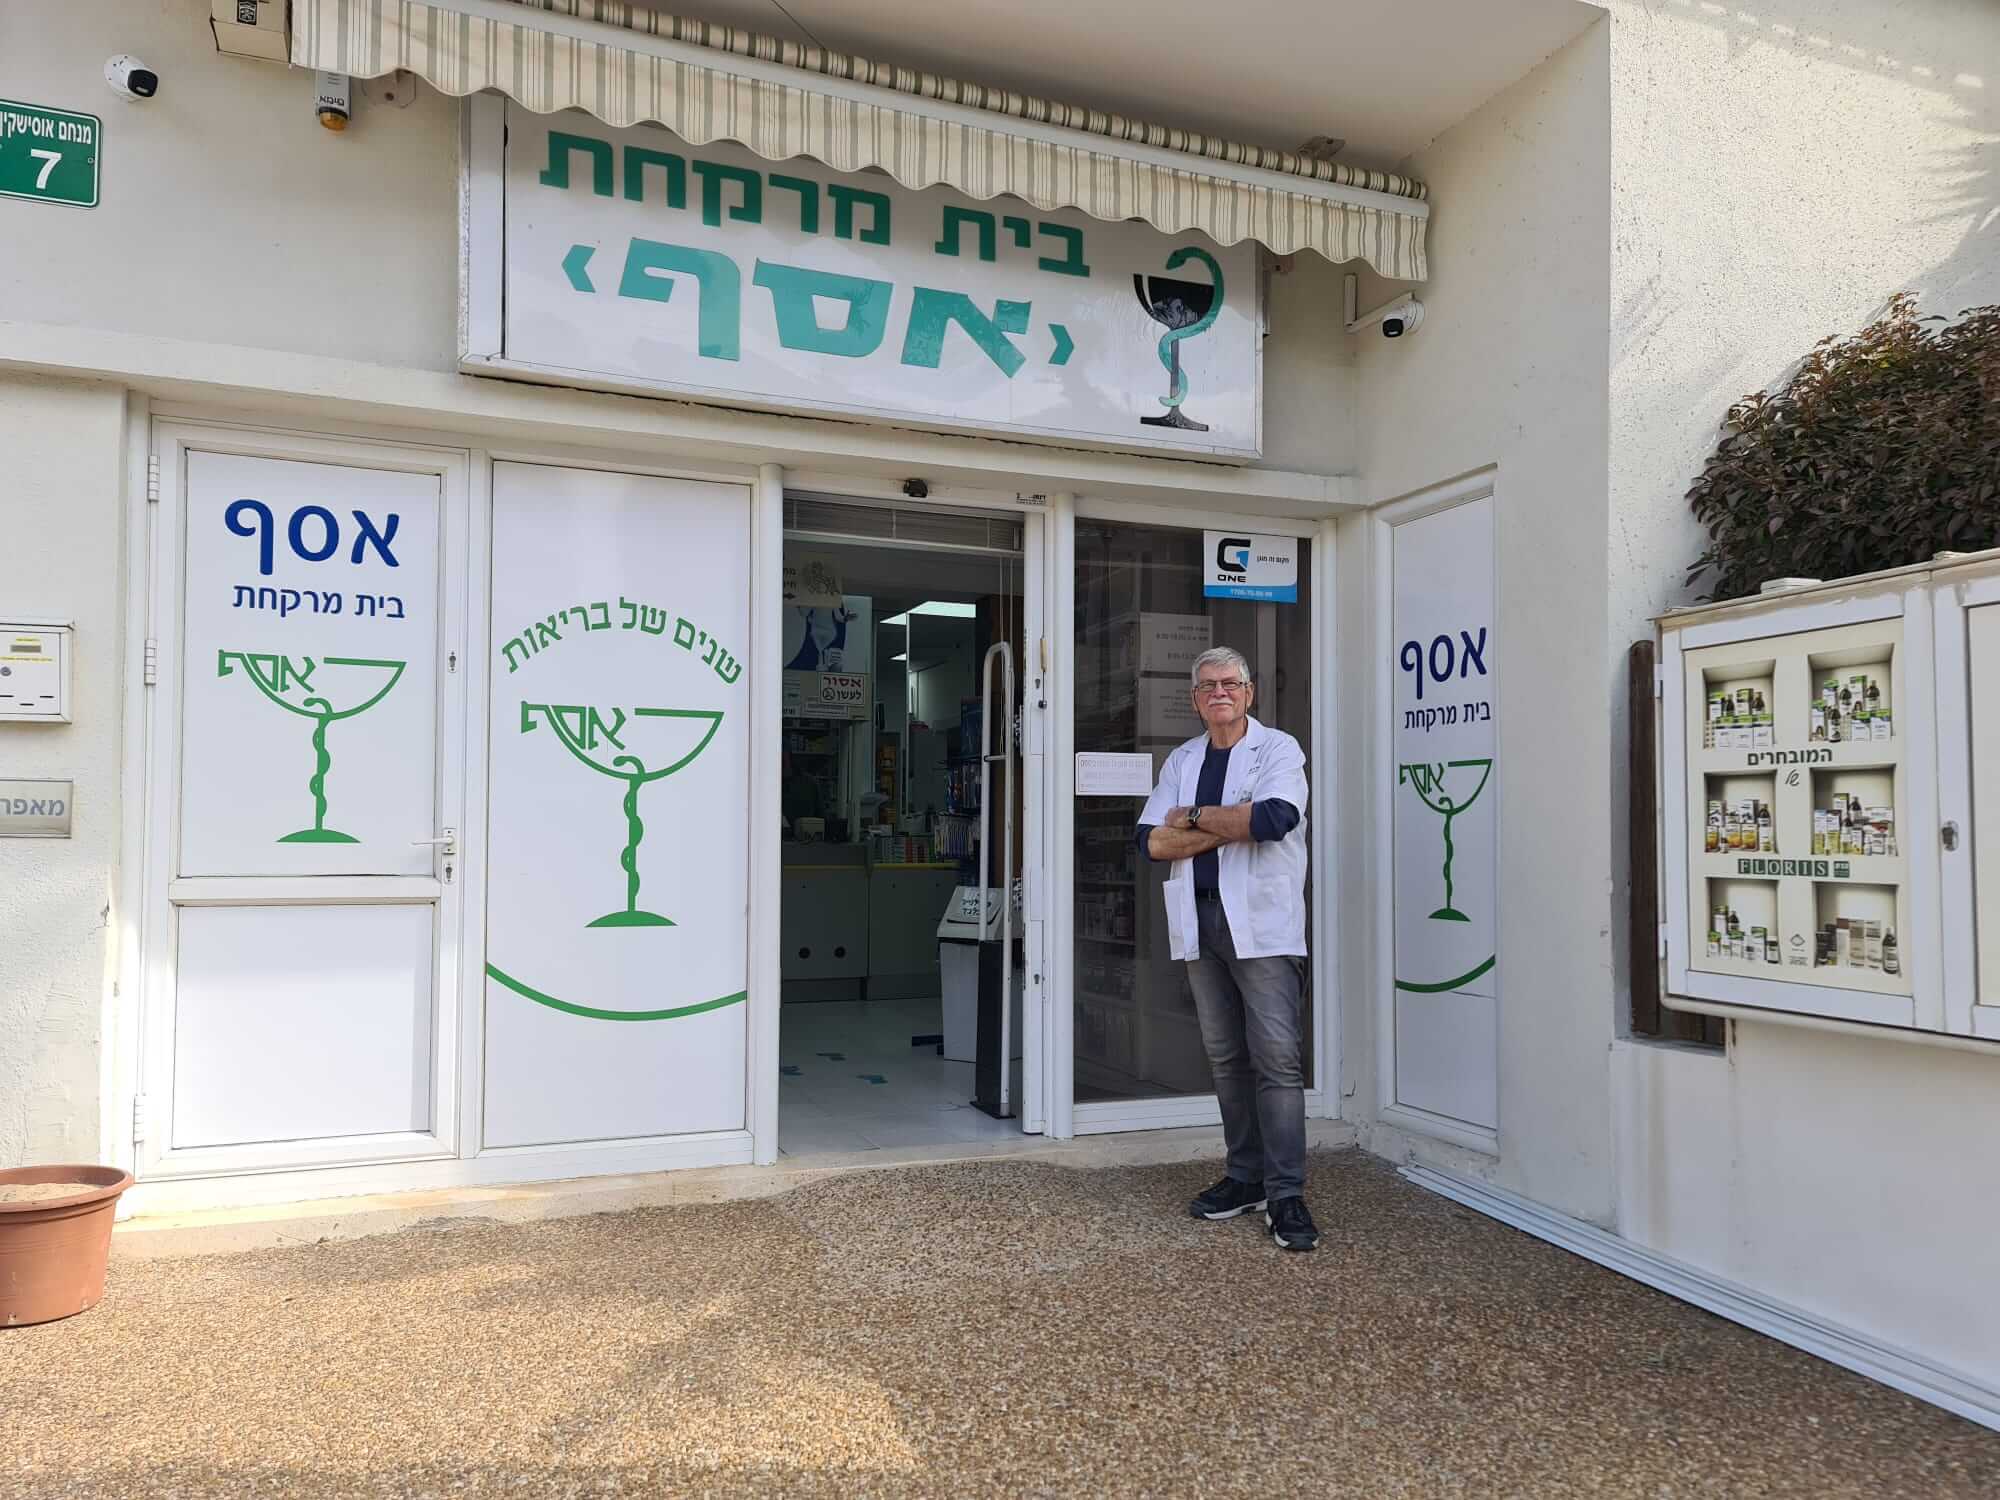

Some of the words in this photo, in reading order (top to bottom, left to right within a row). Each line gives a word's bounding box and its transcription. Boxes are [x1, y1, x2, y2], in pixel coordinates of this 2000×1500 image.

[58, 120, 92, 145] מנחם
[31, 149, 62, 189] 7
[539, 130, 892, 246] מרקחת
[935, 205, 1091, 278] בית
[618, 237, 1032, 378] אסף
[224, 499, 400, 576] אסף
[1217, 574, 1247, 583] ONE
[233, 586, 342, 617] מרקחת
[355, 592, 405, 618] בית
[619, 596, 667, 635] של
[501, 602, 612, 674] בריאות
[673, 616, 743, 684] שנים
[1400, 627, 1487, 700] אסף
[823, 676, 862, 688] אסור
[836, 688, 862, 701] לעשן
[1404, 705, 1457, 733] מרקחת
[1463, 701, 1491, 723] בית
[1747, 748, 1833, 766] המובחרים
[1738, 859, 1829, 877] FLORIS
